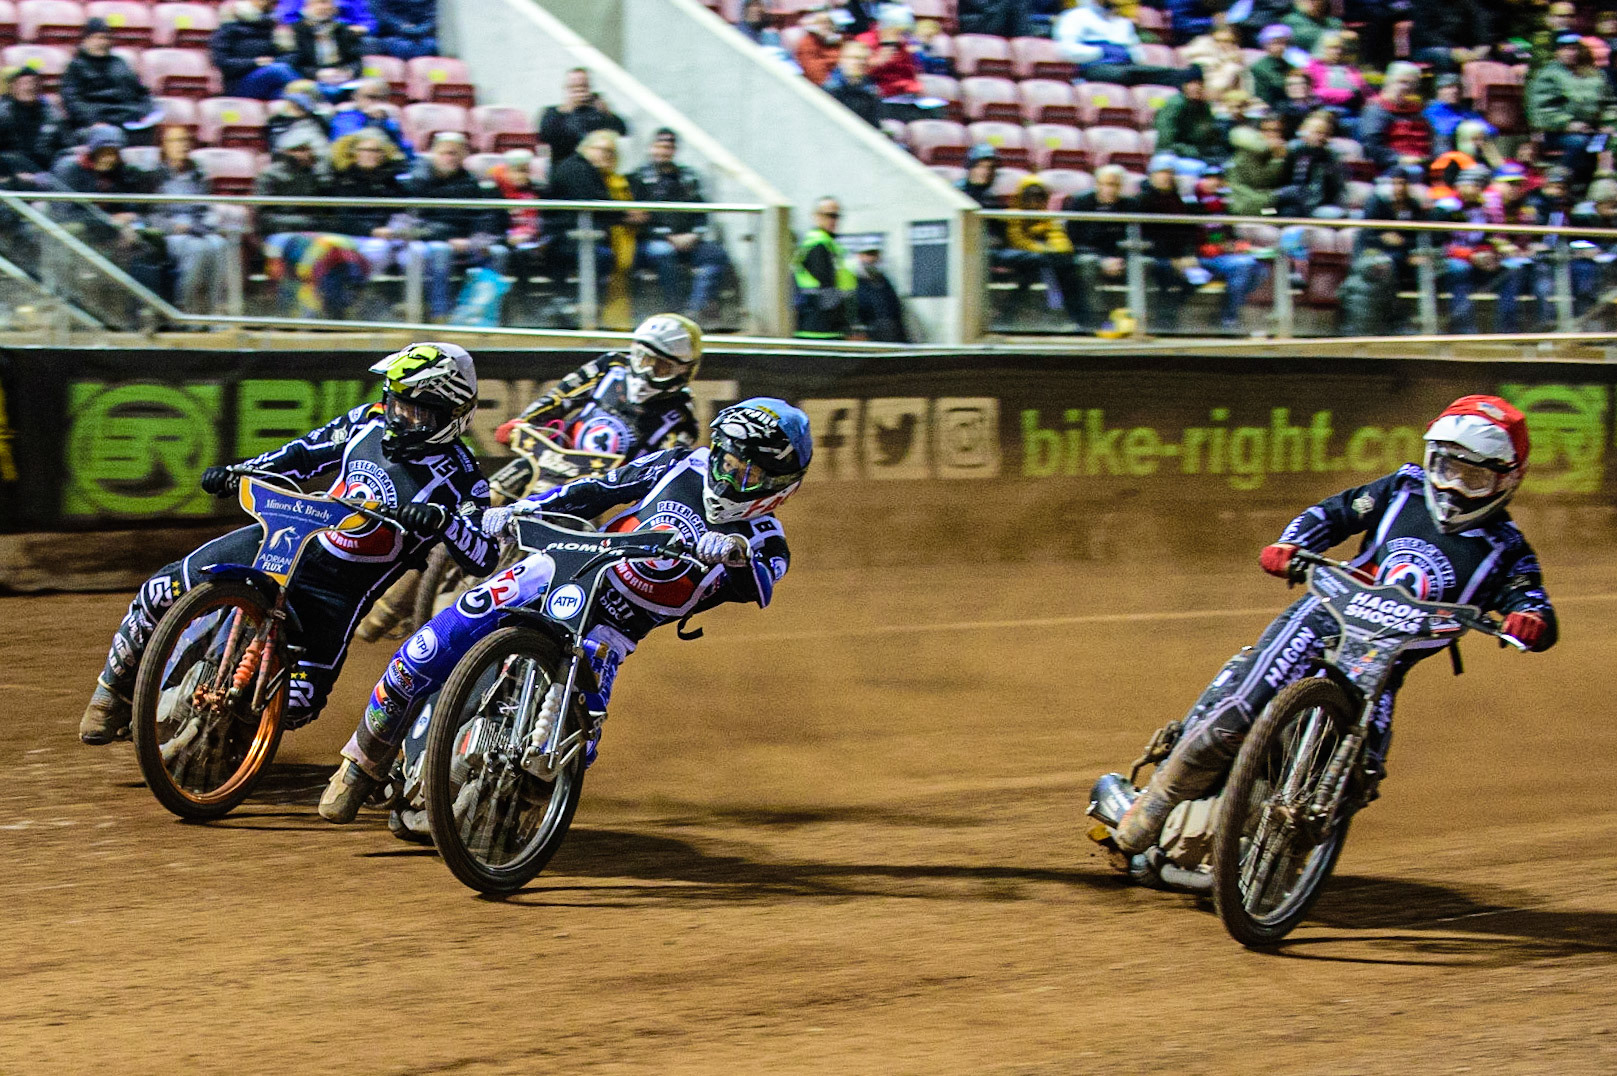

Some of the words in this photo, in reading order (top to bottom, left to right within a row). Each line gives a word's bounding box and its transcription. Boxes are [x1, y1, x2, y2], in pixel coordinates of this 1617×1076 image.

[1021, 407, 1425, 490] bike-right.co
[376, 469, 397, 508] CRAVEN
[265, 499, 292, 511] Minors
[292, 500, 304, 514] &
[305, 505, 333, 522] Brady
[658, 501, 692, 518] PETER
[327, 531, 360, 549] ORIAL
[679, 521, 693, 540] VUE
[258, 553, 293, 566] ADRIAN
[261, 561, 284, 573] FLUX
[615, 559, 655, 594] MORIAL
[553, 596, 578, 608] ATPI
[1350, 592, 1429, 624] HAGON
[1343, 603, 1422, 635] SHOCKS
[415, 632, 430, 656] ATPI
[1264, 626, 1317, 688] HAGON
